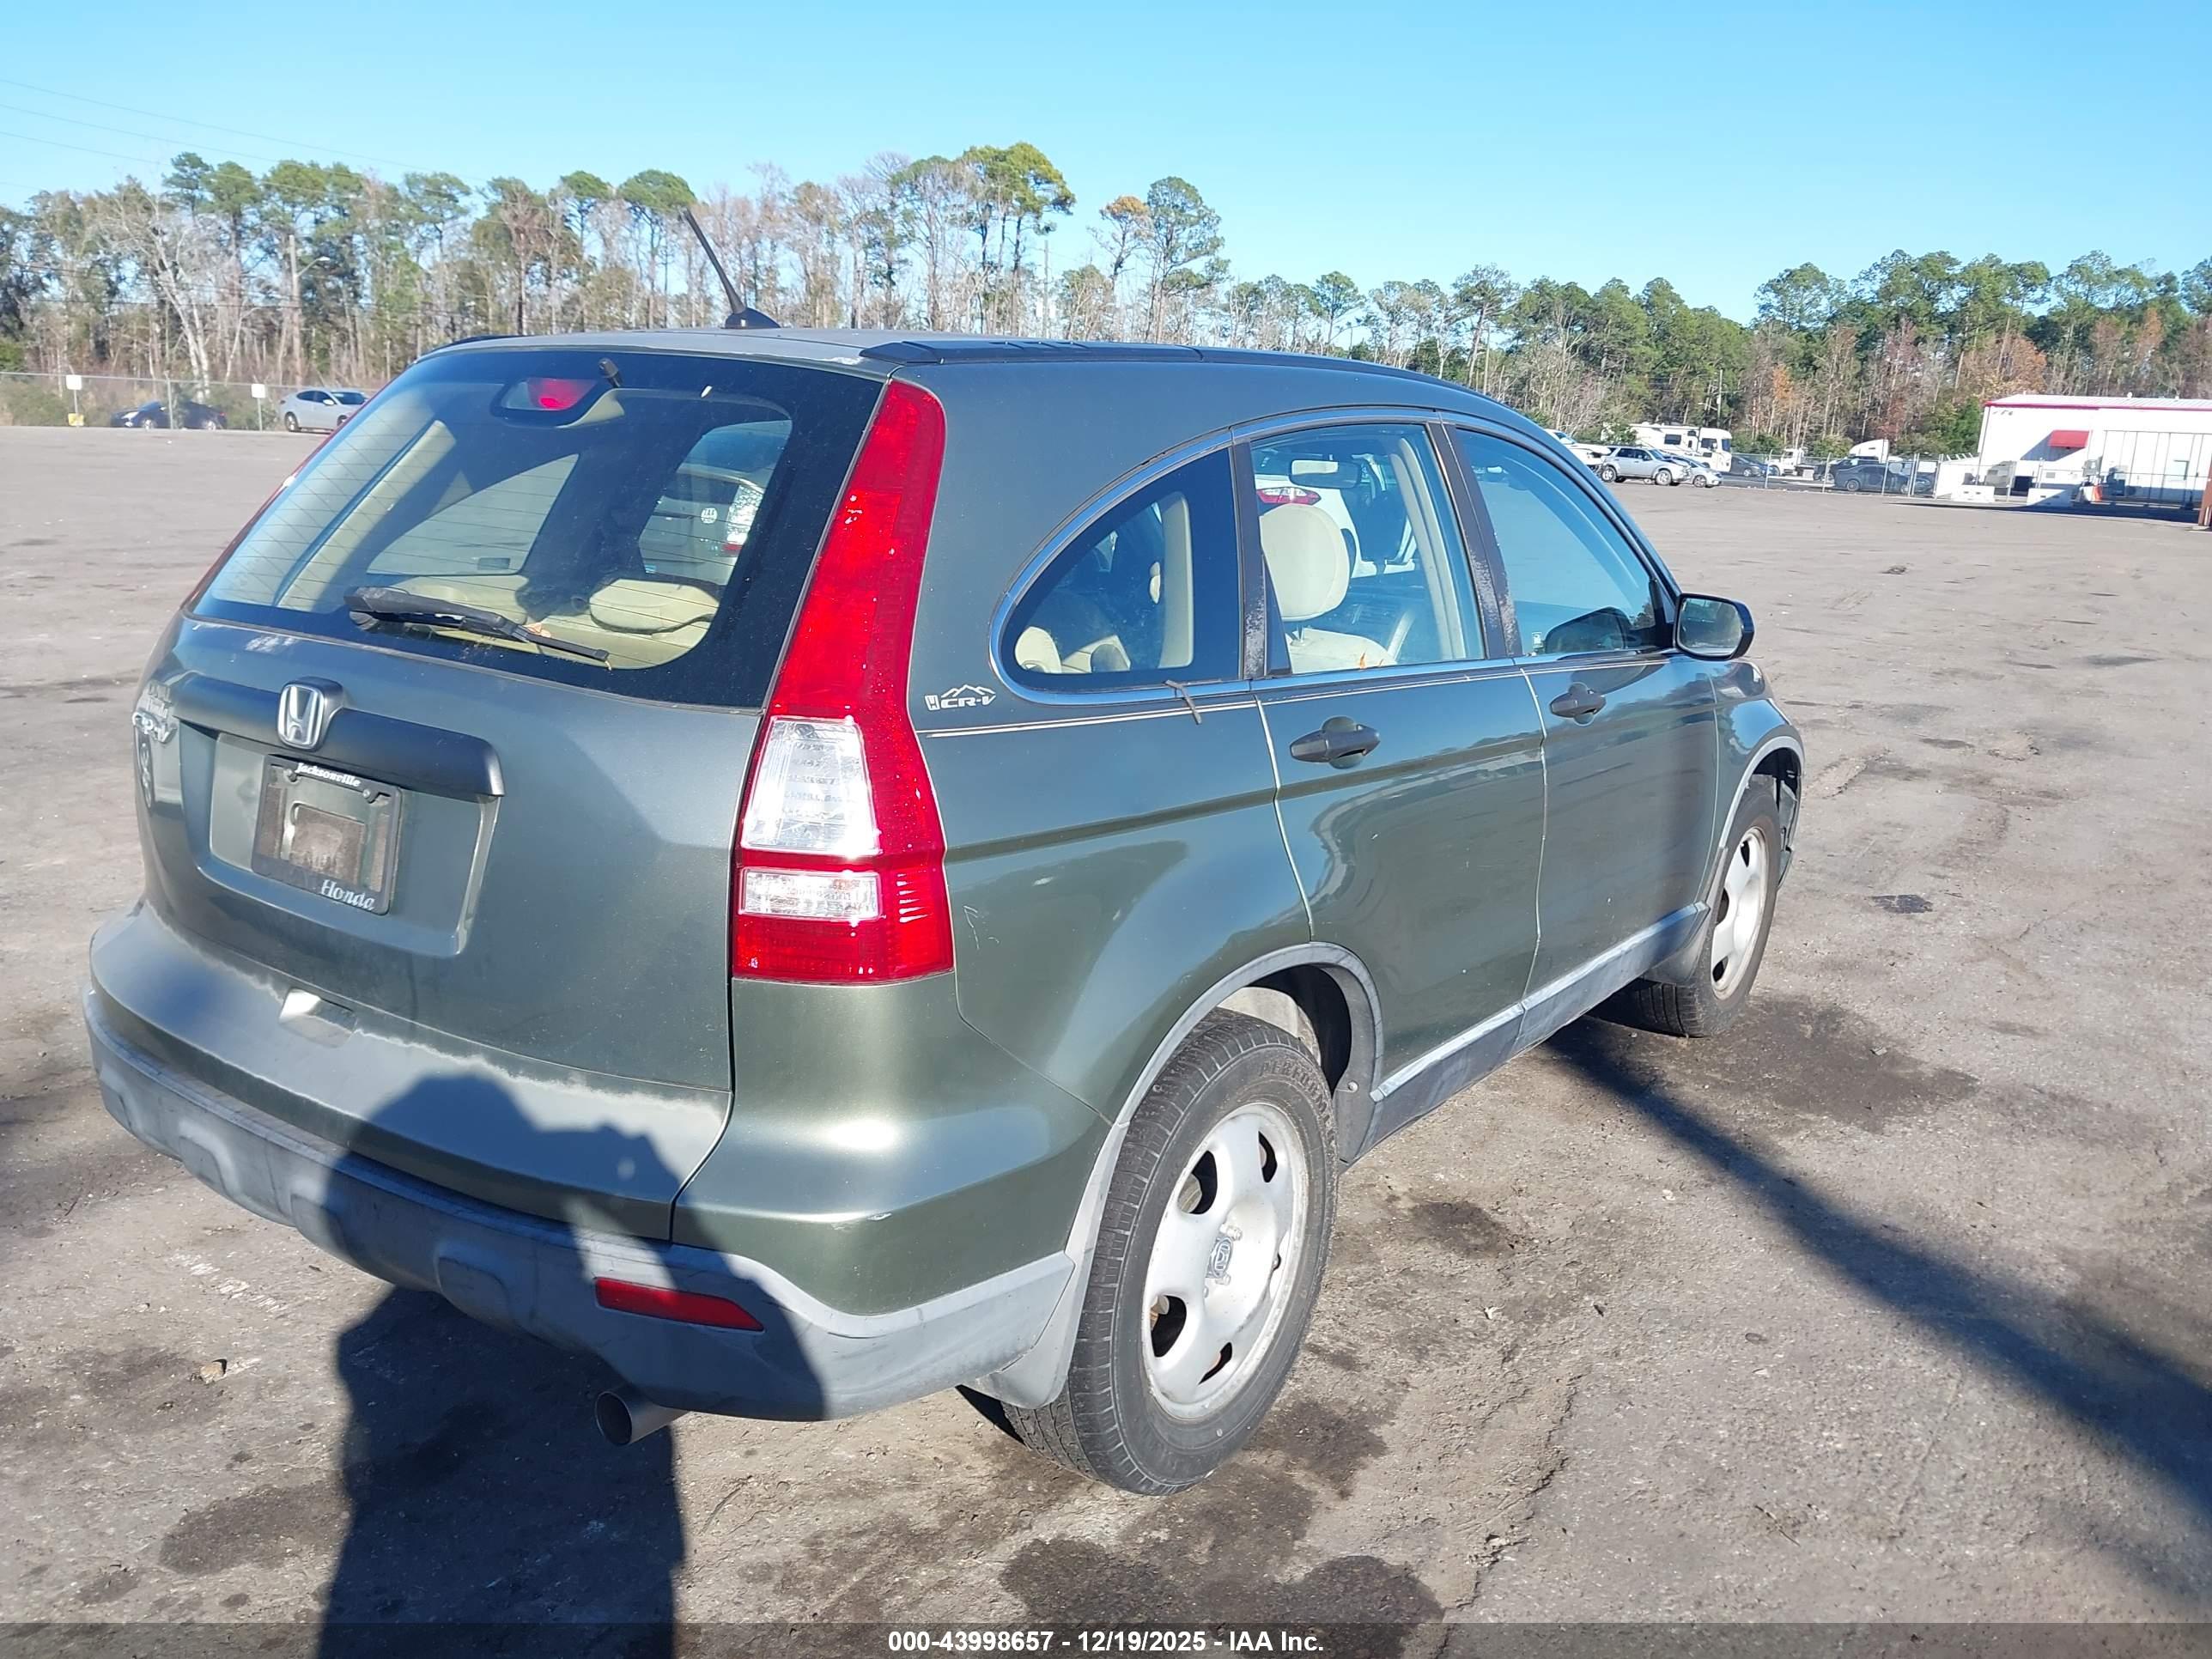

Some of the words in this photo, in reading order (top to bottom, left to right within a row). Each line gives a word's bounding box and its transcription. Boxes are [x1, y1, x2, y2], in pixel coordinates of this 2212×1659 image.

[941, 695, 996, 708] CR-V
[295, 763, 362, 787] Jacksonville
[319, 878, 376, 910] Honda
